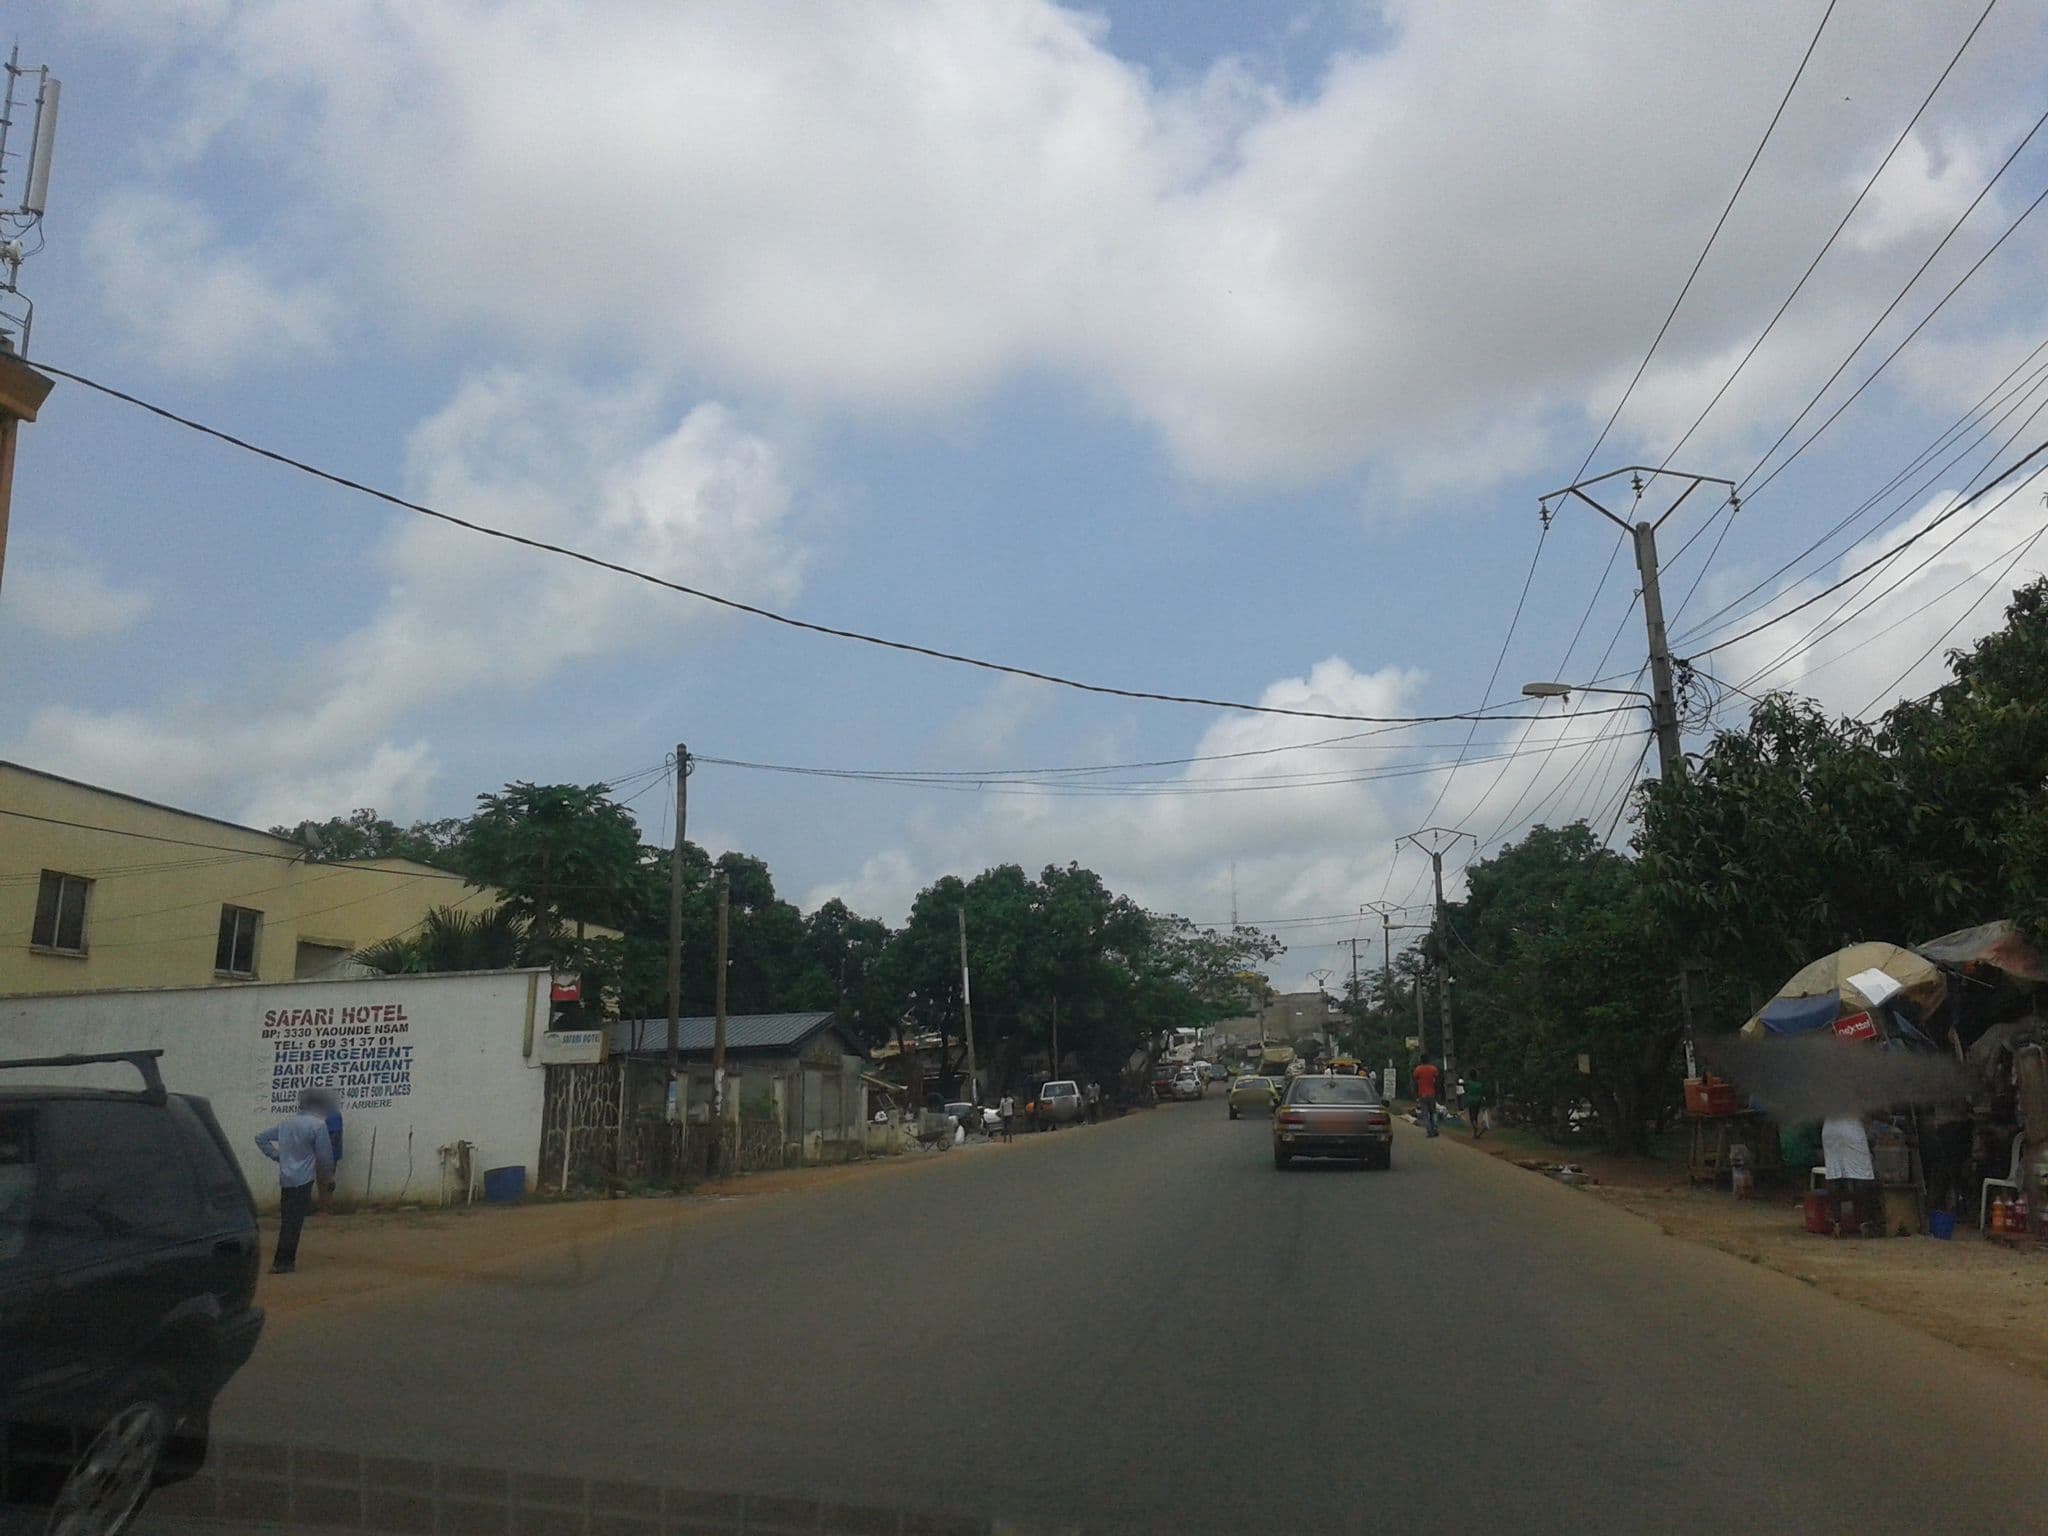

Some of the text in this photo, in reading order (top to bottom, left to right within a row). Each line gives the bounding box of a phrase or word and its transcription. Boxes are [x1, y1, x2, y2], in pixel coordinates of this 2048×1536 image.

[264, 1004, 408, 1027] SAFARI HOTEL
[283, 1027, 312, 1038] 3330
[315, 1025, 371, 1037] YAOUNDE
[374, 1022, 409, 1034] NSAM
[274, 1035, 394, 1050] TEL: 6 99 31 37 01
[275, 1046, 413, 1063] HEBERGEMENT
[271, 1071, 410, 1089] SERVICE TRAITEUR
[271, 1090, 297, 1103] SALLES
[384, 1083, 412, 1096] PLACES
